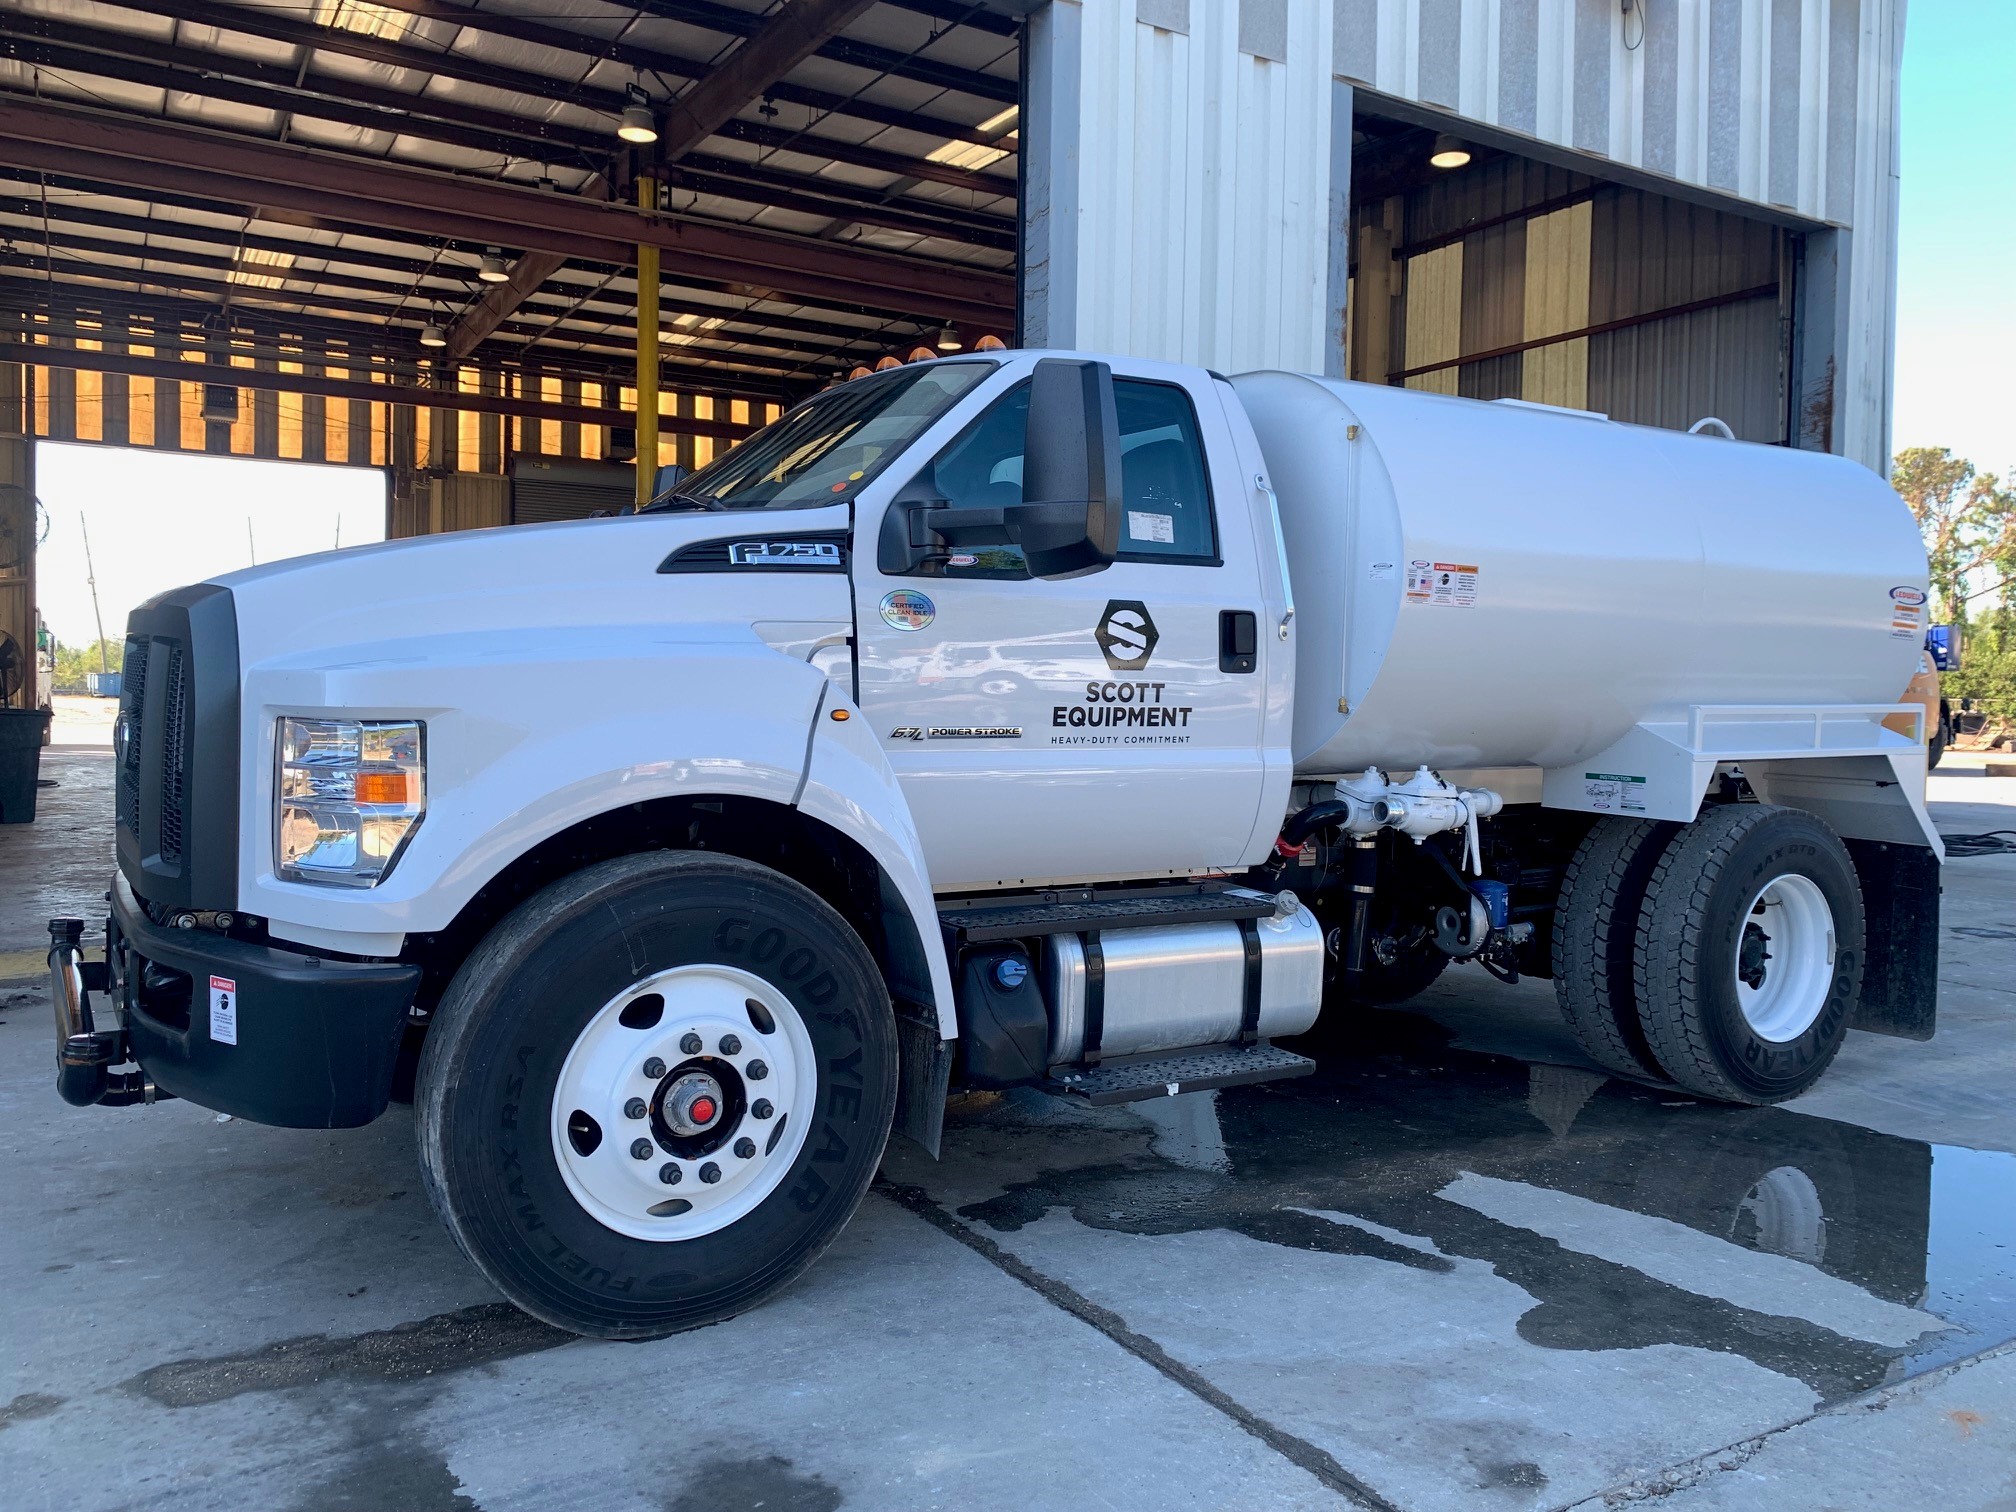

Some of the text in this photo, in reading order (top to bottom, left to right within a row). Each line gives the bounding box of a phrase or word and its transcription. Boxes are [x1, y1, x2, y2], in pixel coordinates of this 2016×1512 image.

[1086, 682, 1166, 703] SCOTT
[1052, 706, 1193, 728] EQUIPMENT
[931, 728, 972, 736] POWER
[974, 727, 1020, 736] STROKE
[1051, 736, 1191, 744] HEAVY-DUTY COMMITMENT
[1599, 774, 1632, 782] INSTRUCTION
[712, 917, 864, 1214] GOODYEAR
[501, 1045, 636, 1293] FUEL MAX RSA
